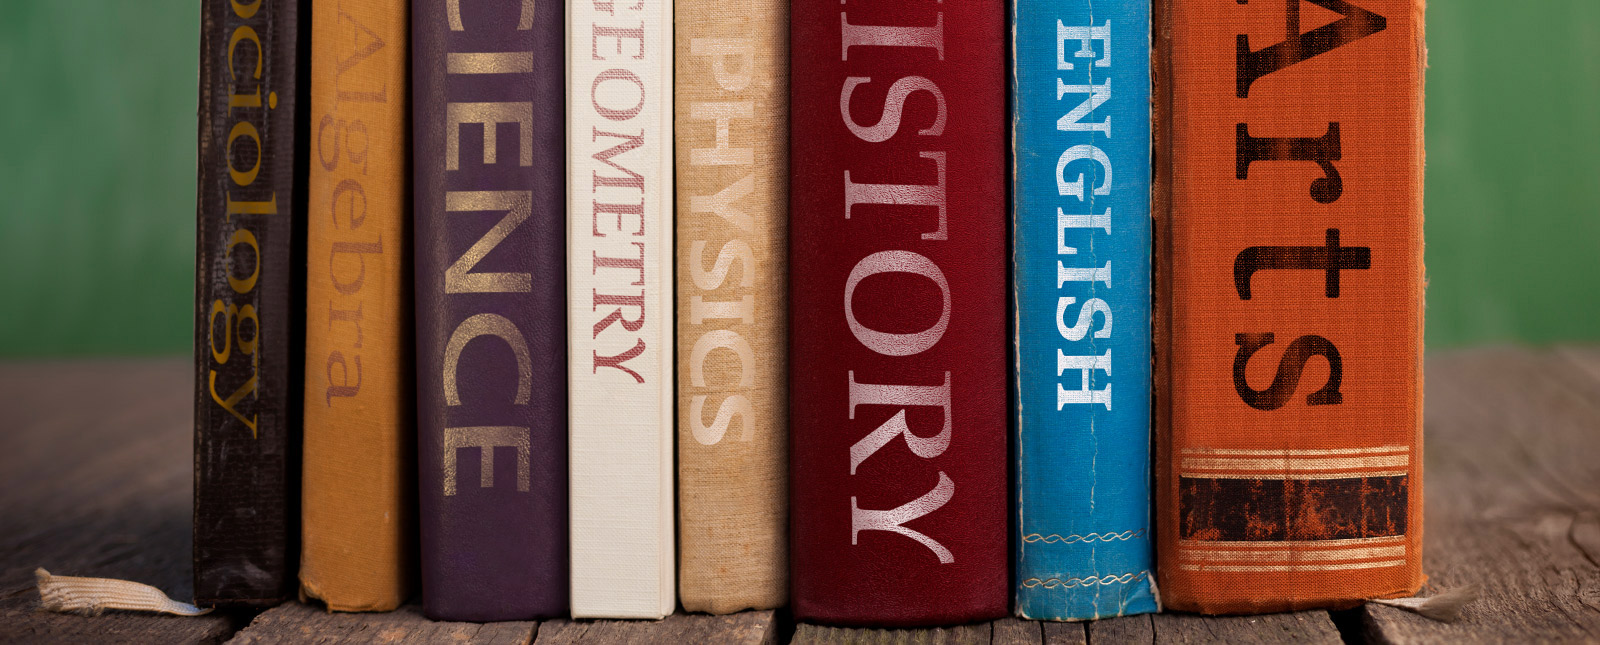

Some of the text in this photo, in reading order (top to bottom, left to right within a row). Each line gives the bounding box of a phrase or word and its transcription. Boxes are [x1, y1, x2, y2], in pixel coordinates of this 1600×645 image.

[210, 0, 278, 439] ciology
[318, 0, 388, 408] Algebra
[591, 0, 646, 384] EOMETRY
[689, 37, 756, 446] PHYSICS
[840, 0, 955, 564] ISTORY
[1056, 19, 1113, 411] ENGLISH
[1233, 0, 1387, 411] Arts
